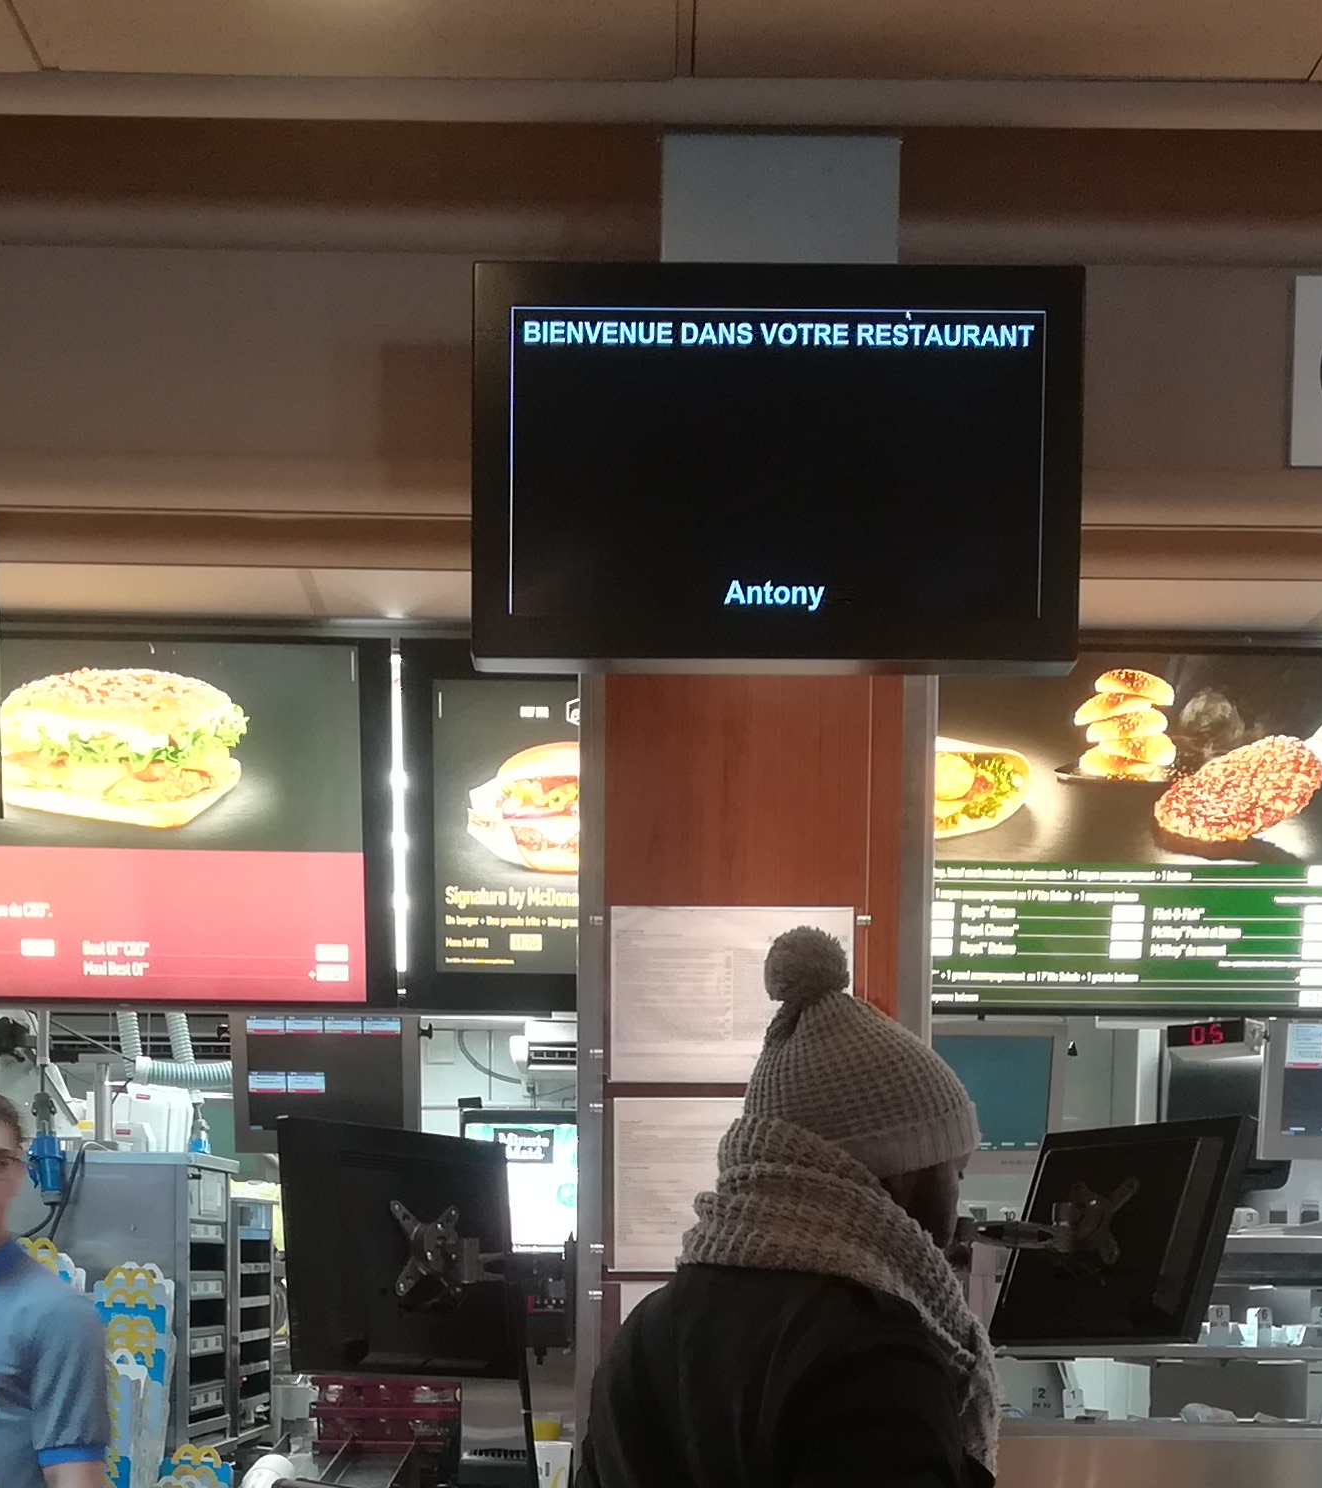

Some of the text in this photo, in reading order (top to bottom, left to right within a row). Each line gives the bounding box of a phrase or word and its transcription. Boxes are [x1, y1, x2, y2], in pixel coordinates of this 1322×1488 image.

[523, 321, 1034, 348] BIENVENUE DANS VOTRE RESTAURANT
[724, 581, 825, 611] Antony
[445, 885, 507, 909] Signature
[509, 886, 526, 911] by
